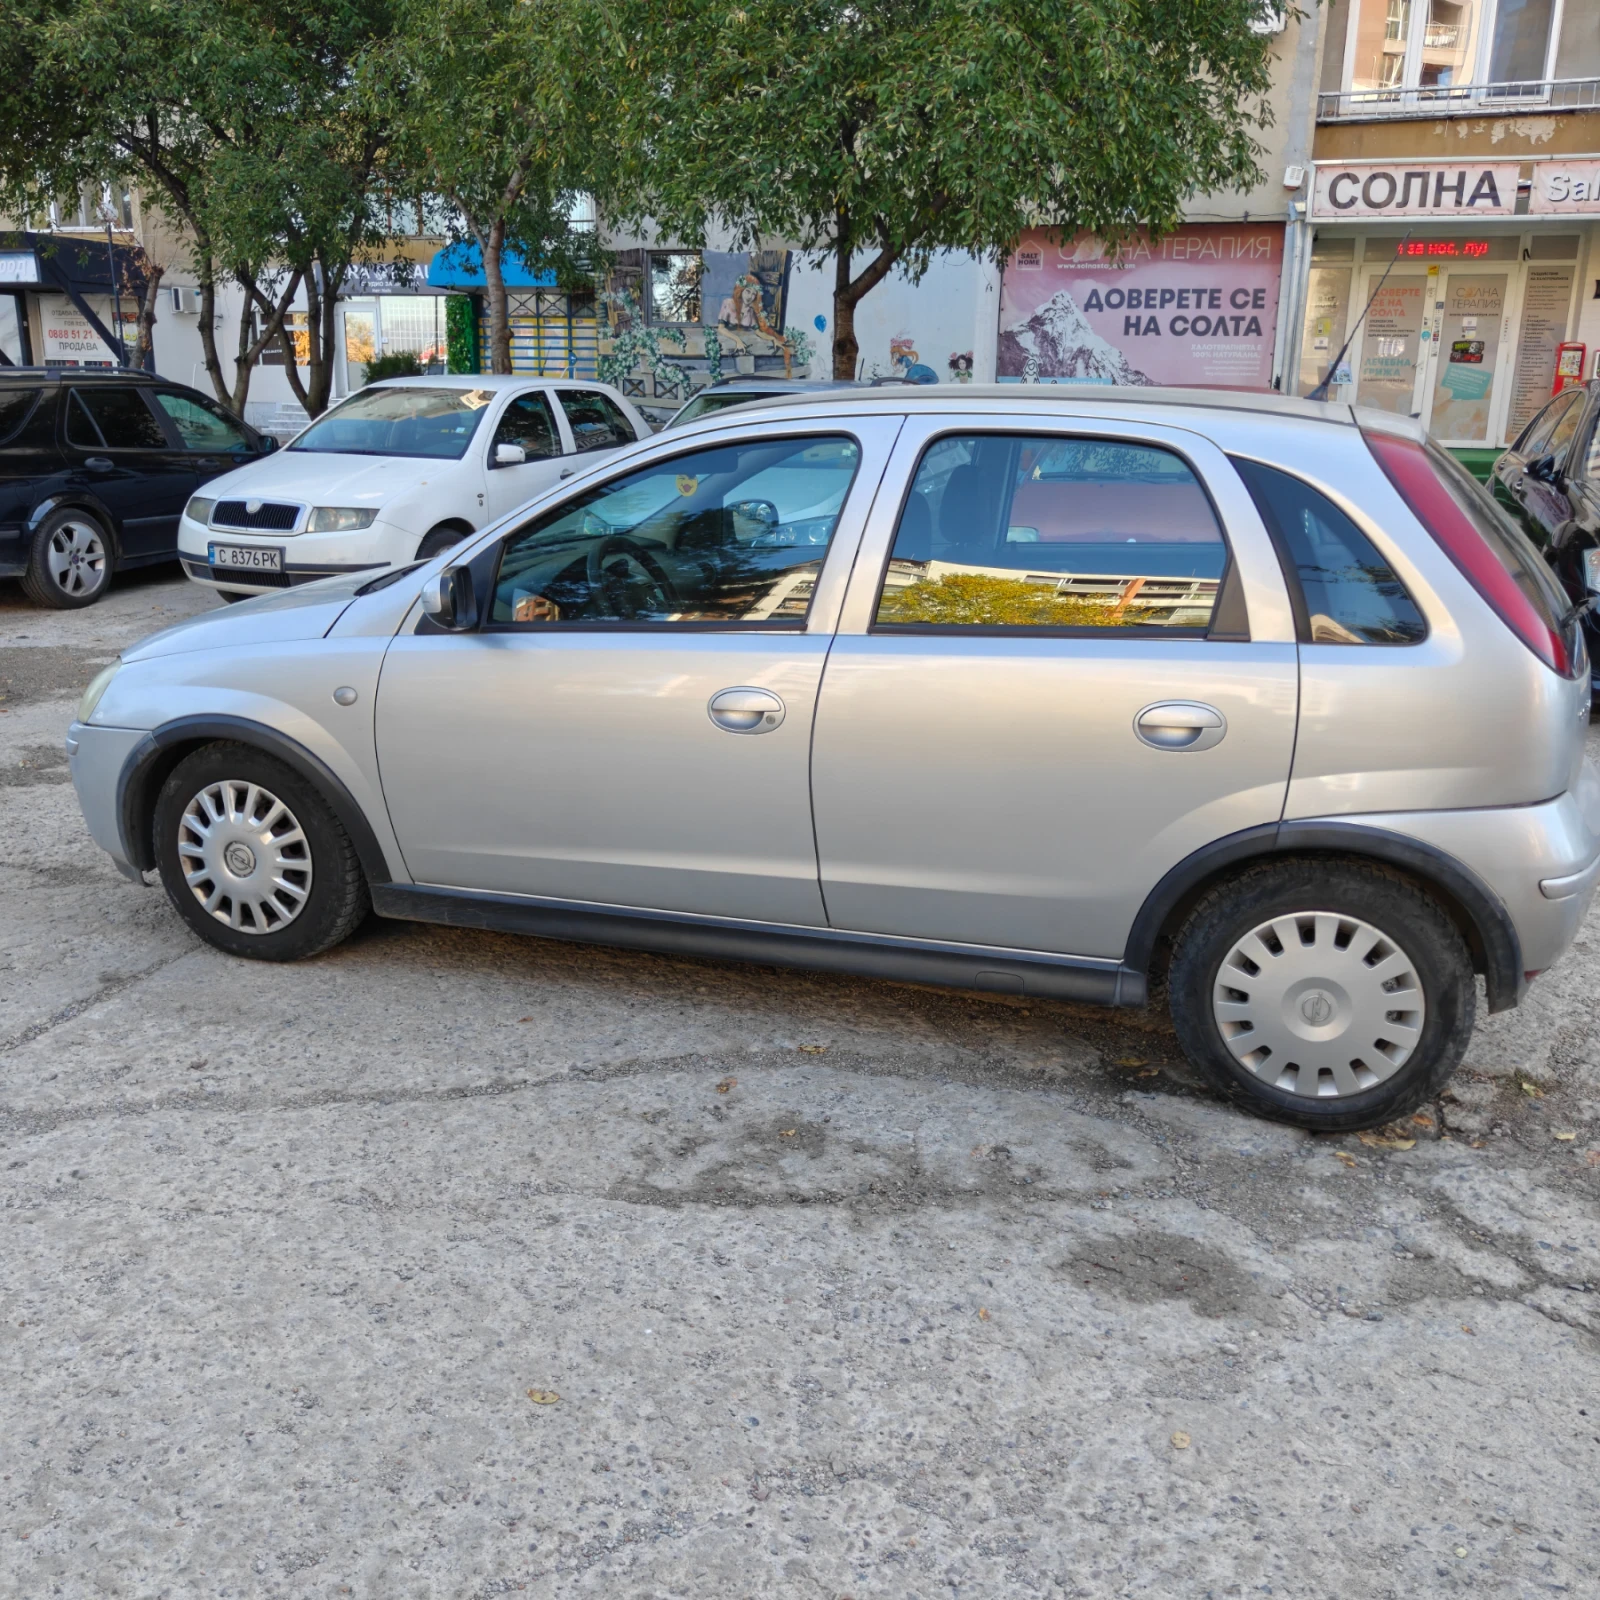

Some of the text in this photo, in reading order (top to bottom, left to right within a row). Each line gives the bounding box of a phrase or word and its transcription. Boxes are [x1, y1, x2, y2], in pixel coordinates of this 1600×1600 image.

[1328, 170, 1502, 210] СОЛНА
[1058, 236, 1272, 261] СНА ТЕРАПИЯ
[1407, 243, 1425, 255] за
[1057, 262, 1136, 271] www.solnastaaom
[1084, 288, 1266, 313] ДОВЕРЕТЕ СЕ
[1451, 298, 1502, 309] ТЕРАПИЯ
[1369, 308, 1406, 317] СОЛТА
[1123, 315, 1263, 337] НА СОЛТА
[48, 329, 68, 339] 0888
[71, 330, 80, 339] 51
[83, 330, 93, 340] 21
[58, 341, 98, 351] ПРОДАВА
[1362, 367, 1401, 377] ГРИЖА
[219, 549, 278, 567] C 8376 PK
